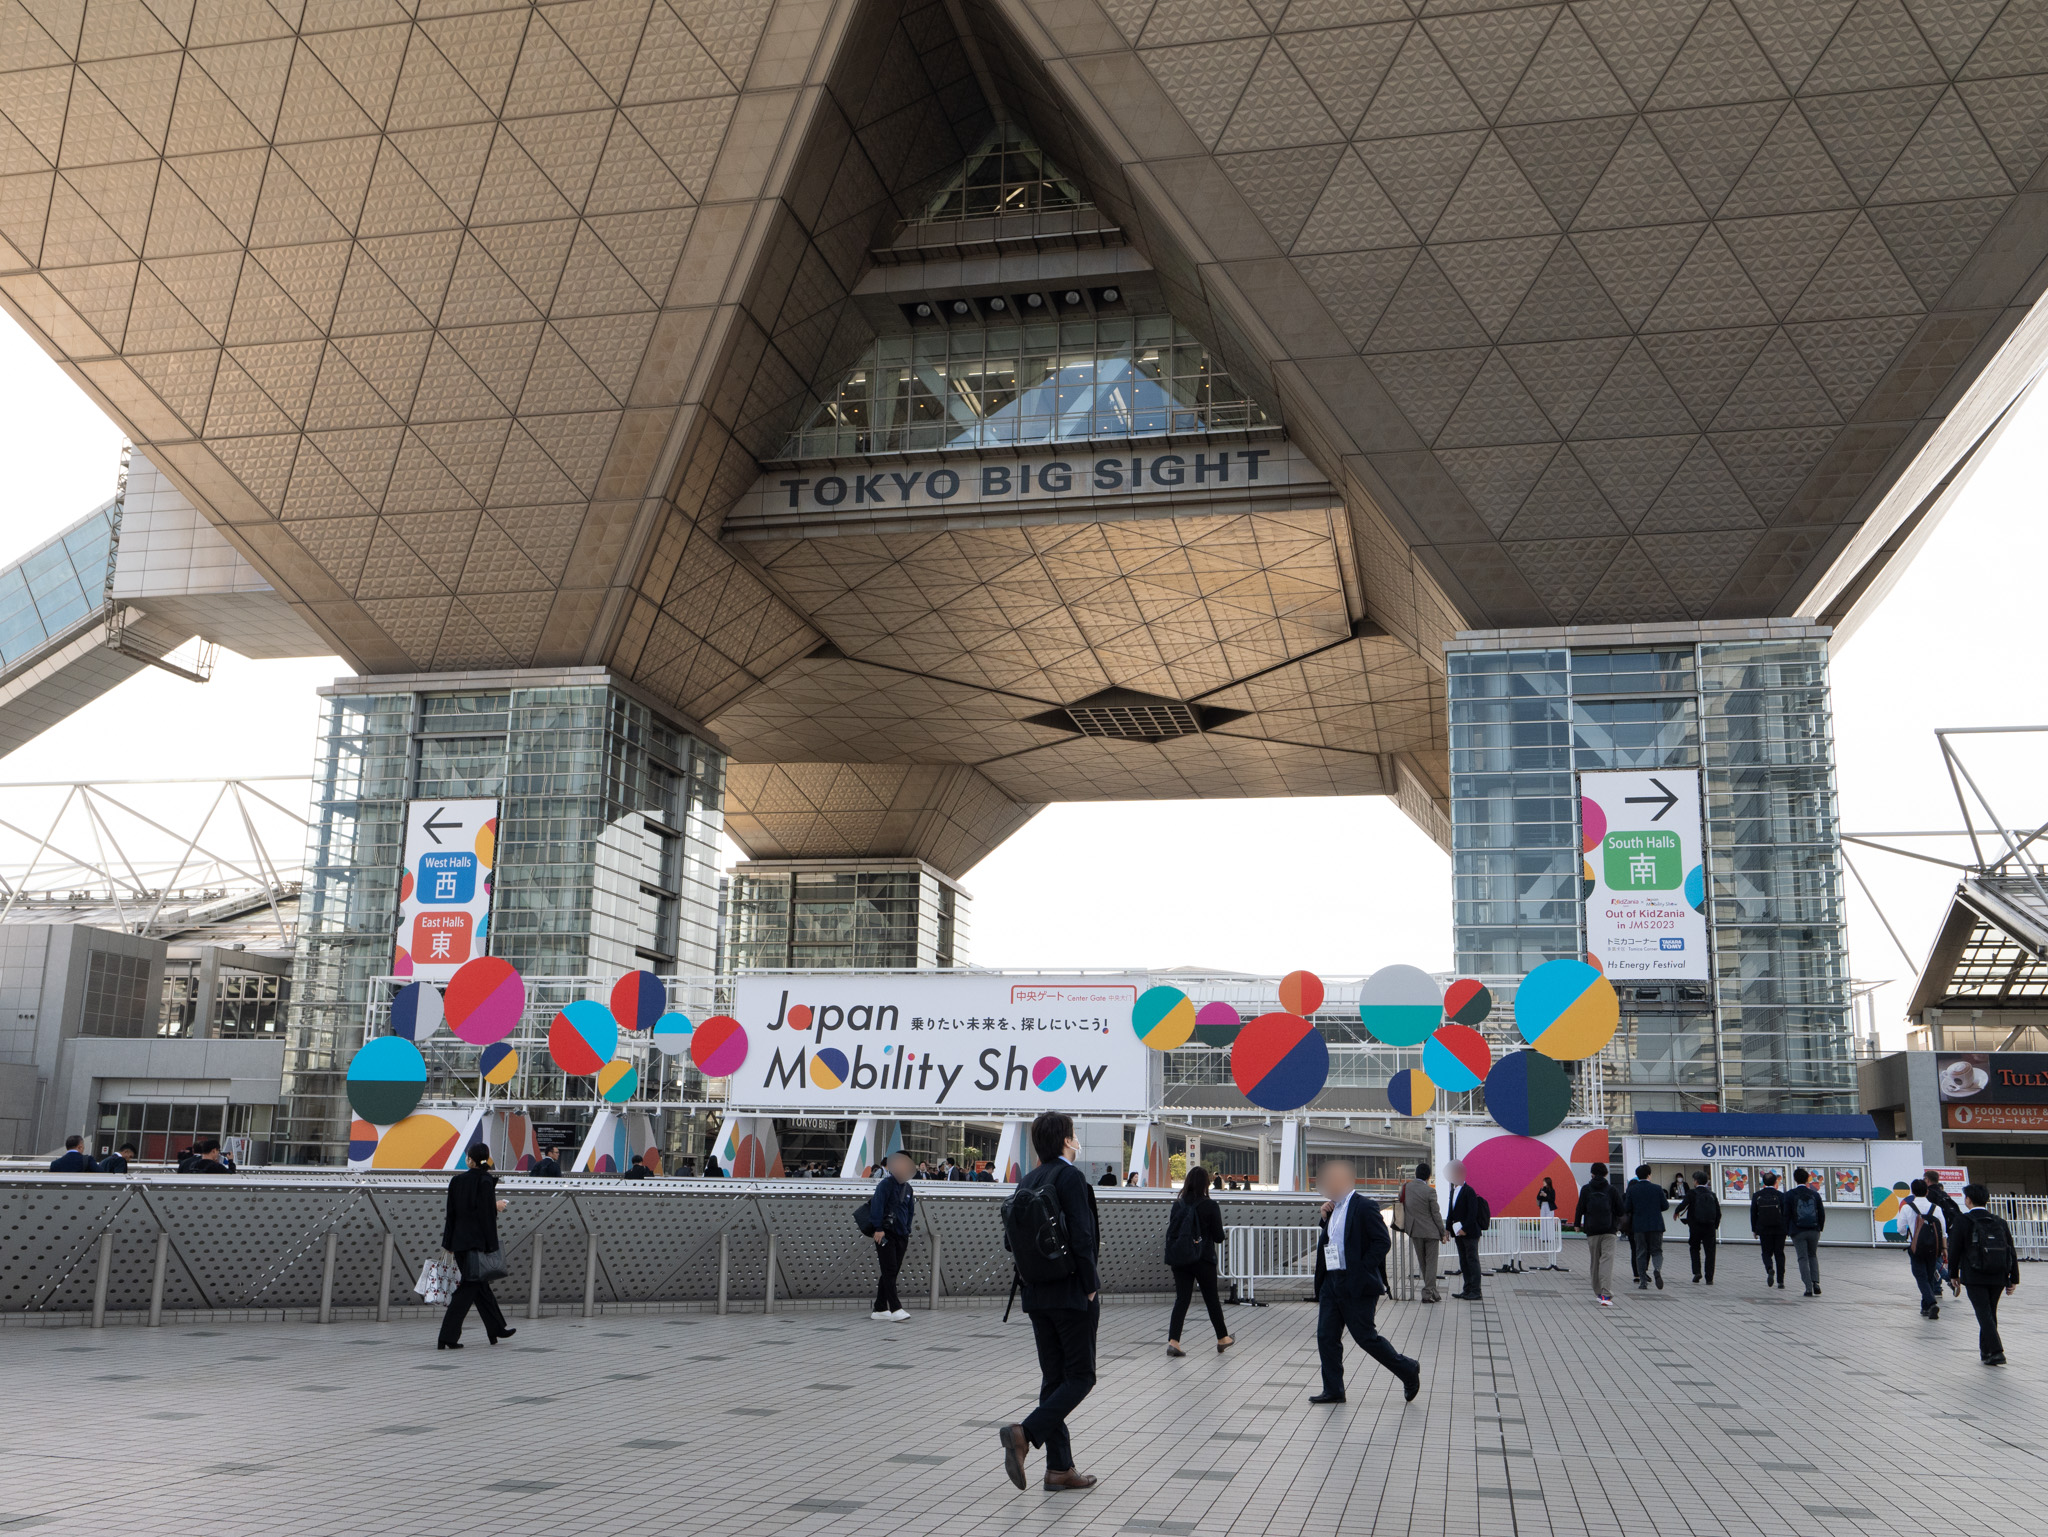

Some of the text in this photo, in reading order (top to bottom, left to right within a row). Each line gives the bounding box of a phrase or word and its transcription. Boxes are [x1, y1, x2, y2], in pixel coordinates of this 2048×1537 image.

[780, 448, 1271, 508] TOKYO BIG SIGHT
[1608, 835, 1676, 850] South Halls
[425, 856, 472, 869] West Halls
[1628, 852, 1657, 885] 南
[434, 871, 458, 899] 西
[1605, 909, 1685, 918] Out of KidZania
[421, 916, 465, 928] East Halls
[1617, 921, 1626, 929] in
[430, 930, 453, 960] 東
[1607, 937, 1657, 946] トミカコーナー
[1619, 960, 1650, 971] Energy
[1653, 959, 1686, 969] Festival
[1016, 990, 1065, 1002] 中央ゲート
[1067, 994, 1088, 1002] Center
[1090, 994, 1107, 1002] Gate
[767, 990, 900, 1044] Japan
[763, 1044, 1109, 1104] Mobility Show
[1974, 1107, 2002, 1115] FOOD
[2005, 1107, 2038, 1116] COURT
[791, 1118, 818, 1129] TOKYO
[1718, 1144, 1805, 1158] INFORMATION
